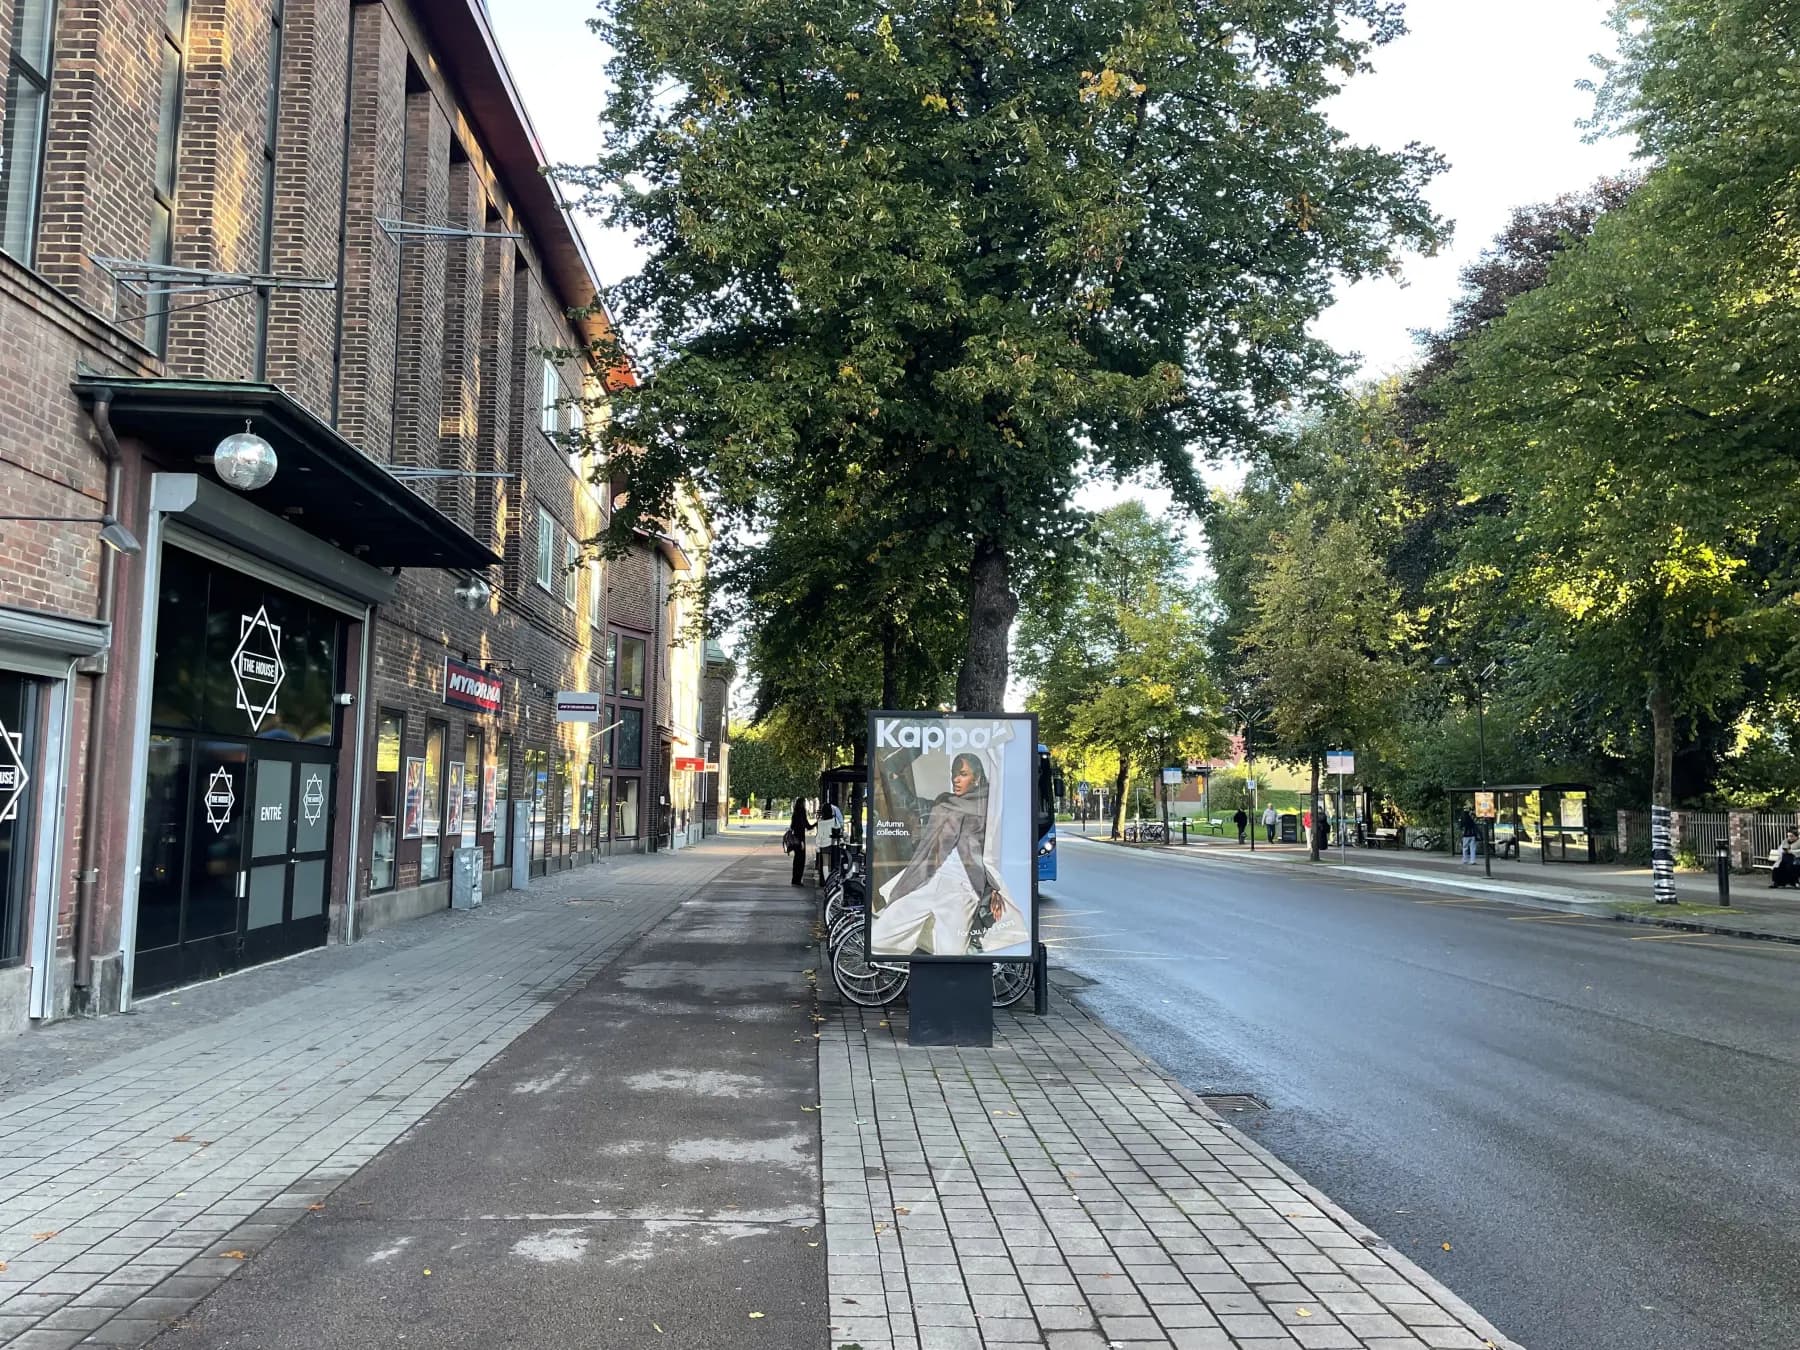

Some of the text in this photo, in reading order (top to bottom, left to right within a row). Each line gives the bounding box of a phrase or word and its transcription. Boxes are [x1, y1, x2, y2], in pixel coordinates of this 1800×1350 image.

[243, 657, 275, 677] THE HOUSE
[449, 672, 500, 703] MYRORNA
[260, 803, 282, 821] ENTRÉ
[876, 820, 905, 828] Autumn
[876, 828, 911, 836] collection.
